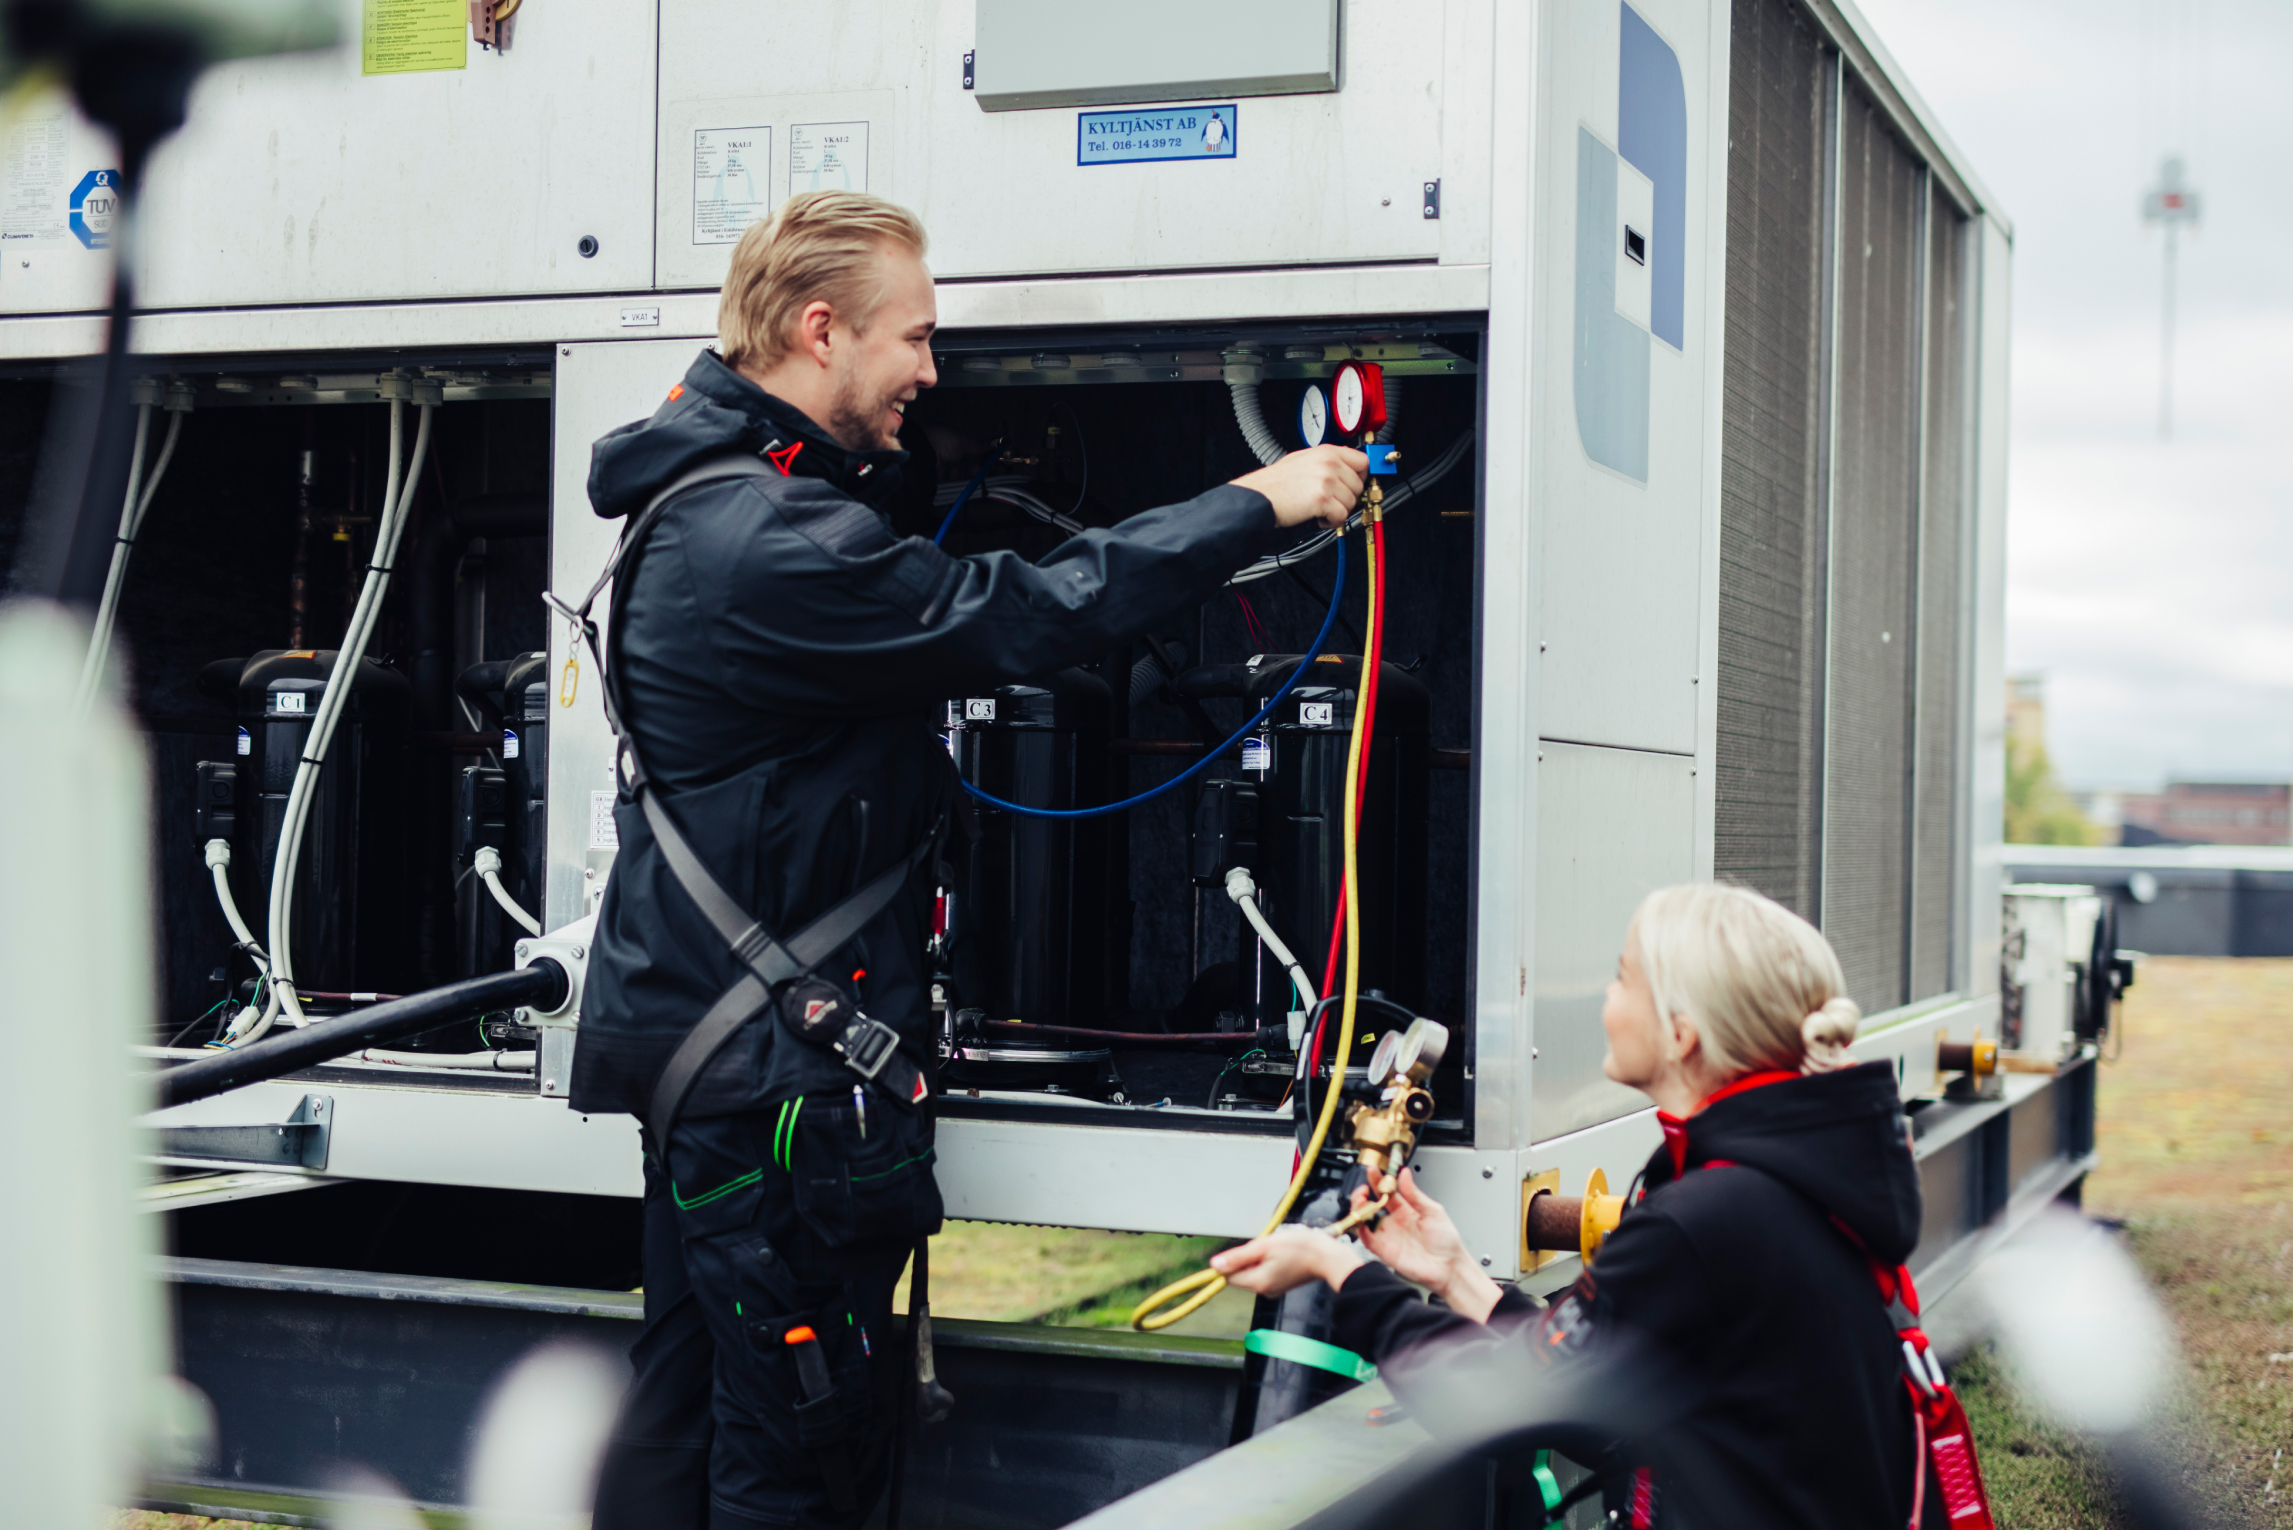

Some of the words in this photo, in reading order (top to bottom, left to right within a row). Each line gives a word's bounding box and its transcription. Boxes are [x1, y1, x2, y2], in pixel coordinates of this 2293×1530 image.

[1088, 117, 1174, 136] KYLTJÄNST
[1176, 117, 1196, 130] AB
[1088, 141, 1108, 151] Tel.
[1152, 138, 1166, 148] 39
[1168, 138, 1182, 147] 72
[87, 198, 115, 214] TÜV
